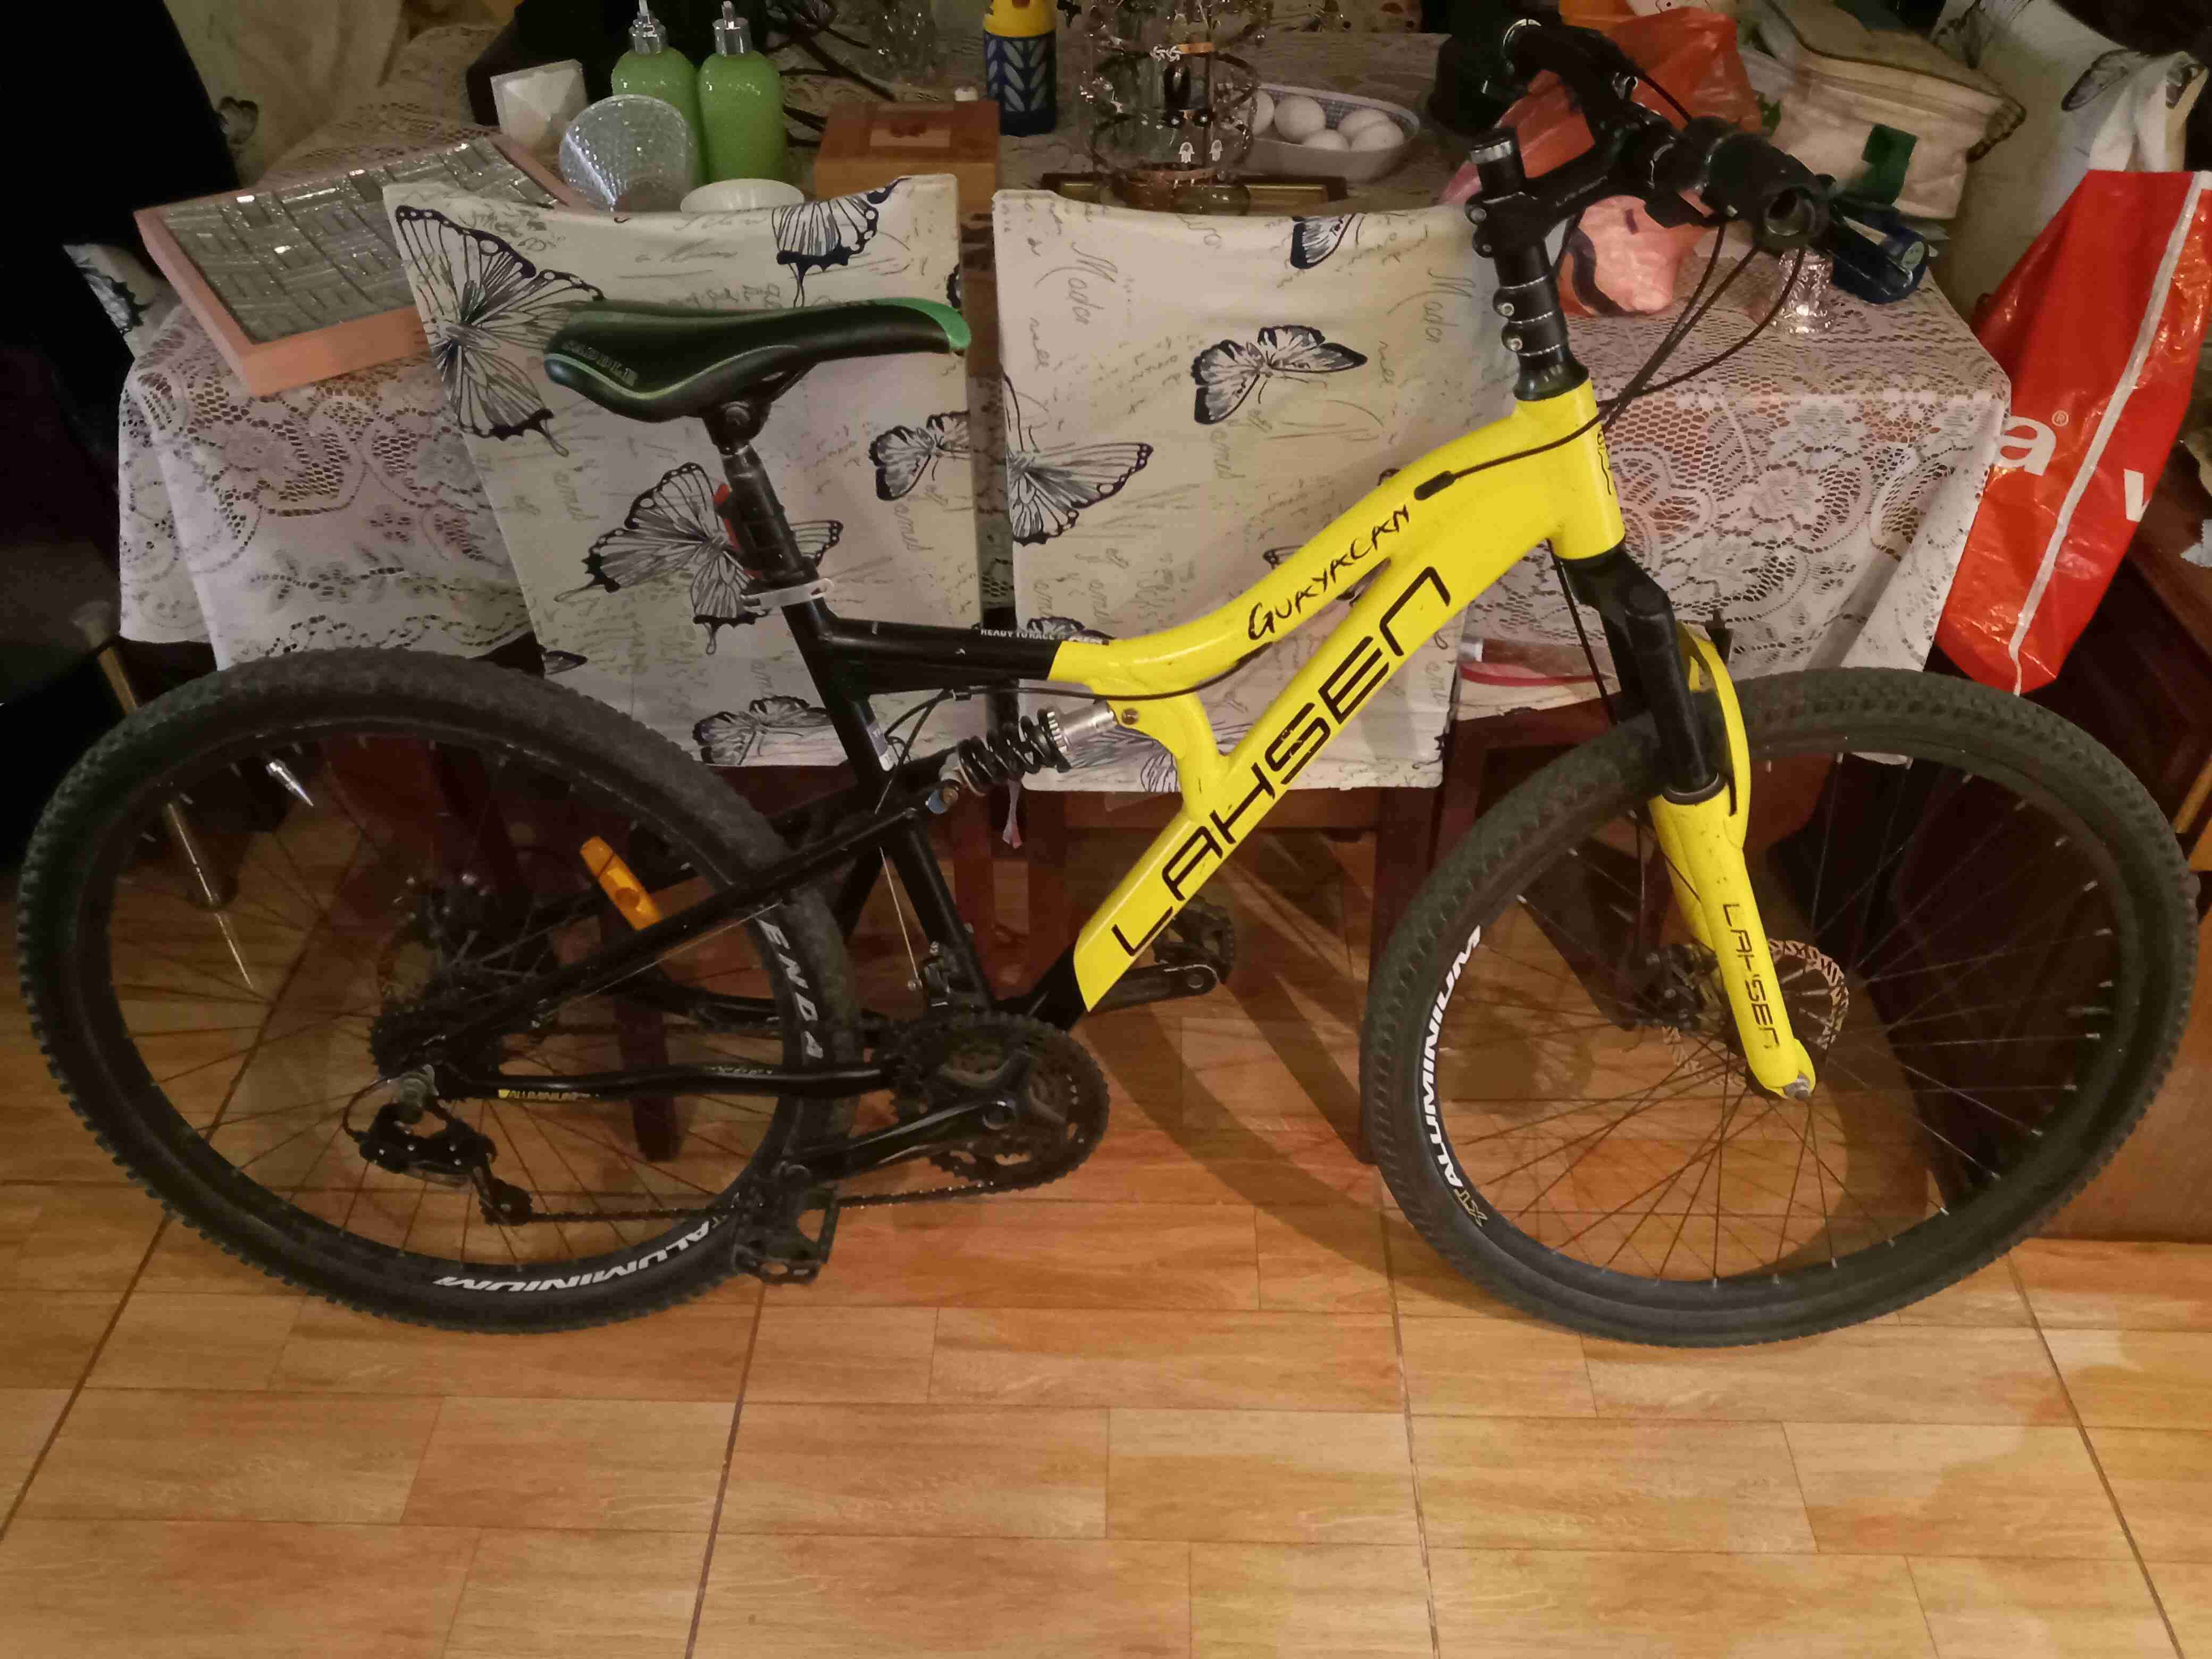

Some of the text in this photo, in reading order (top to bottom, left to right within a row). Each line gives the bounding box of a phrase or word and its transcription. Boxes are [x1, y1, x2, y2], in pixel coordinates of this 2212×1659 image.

[1247, 504, 1410, 640] GUAYACAN
[1112, 566, 1452, 958] LAHSEN
[1422, 924, 1481, 1187] ALUMINIUM
[432, 1220, 710, 1293] ALUMINIUM
